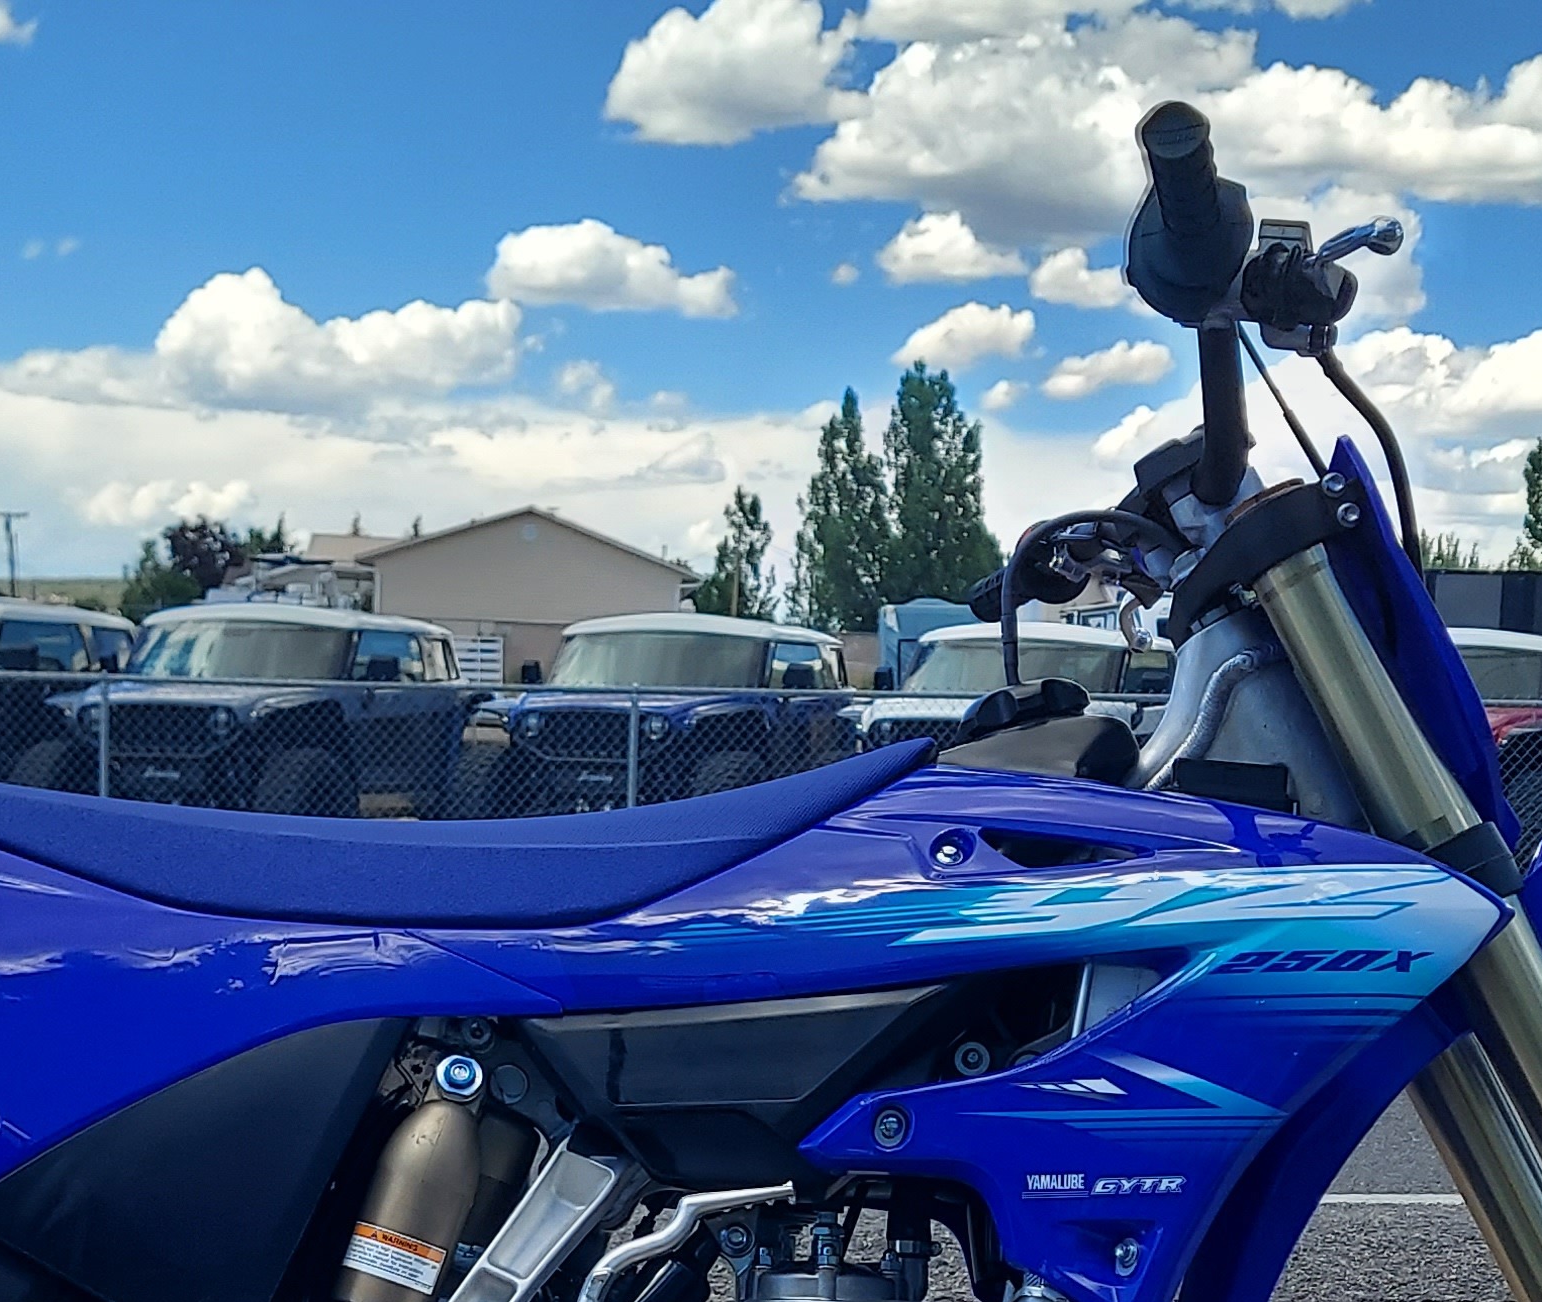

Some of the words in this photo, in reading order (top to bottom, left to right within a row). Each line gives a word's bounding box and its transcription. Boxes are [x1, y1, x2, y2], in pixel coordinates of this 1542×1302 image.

[1216, 949, 1436, 974] 250X
[1026, 1173, 1085, 1190] YAMALUBE
[1091, 1175, 1187, 1195] GYTR
